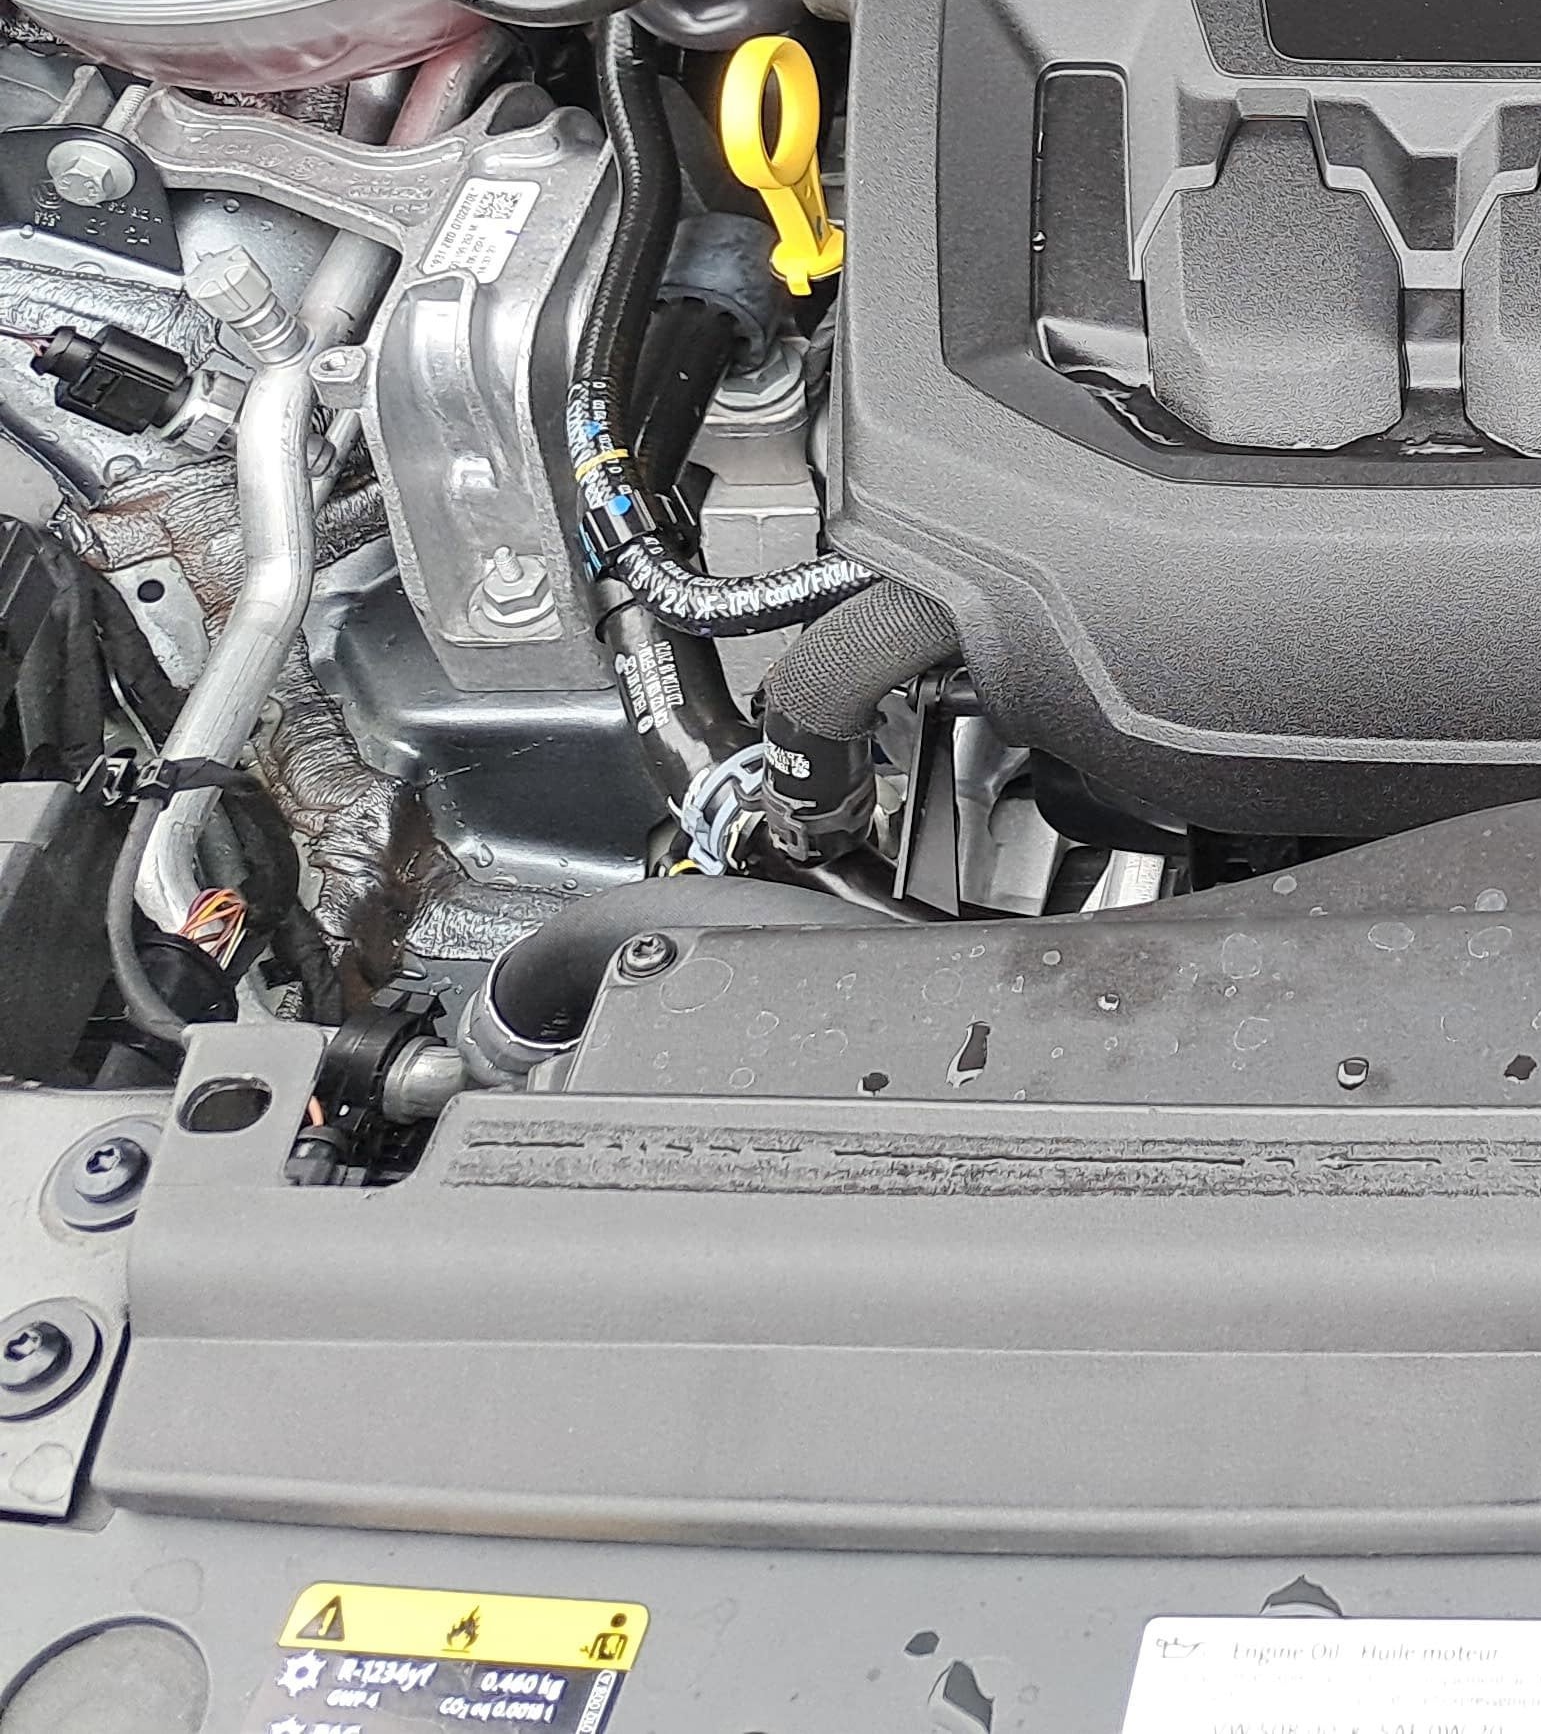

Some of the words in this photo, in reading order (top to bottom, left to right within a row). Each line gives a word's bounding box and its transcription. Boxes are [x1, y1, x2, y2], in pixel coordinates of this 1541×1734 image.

[1233, 1641, 1304, 1664] Engine
[1311, 1642, 1341, 1661] Oil
[1360, 1642, 1416, 1661] Huile
[1423, 1642, 1500, 1662] moteur
